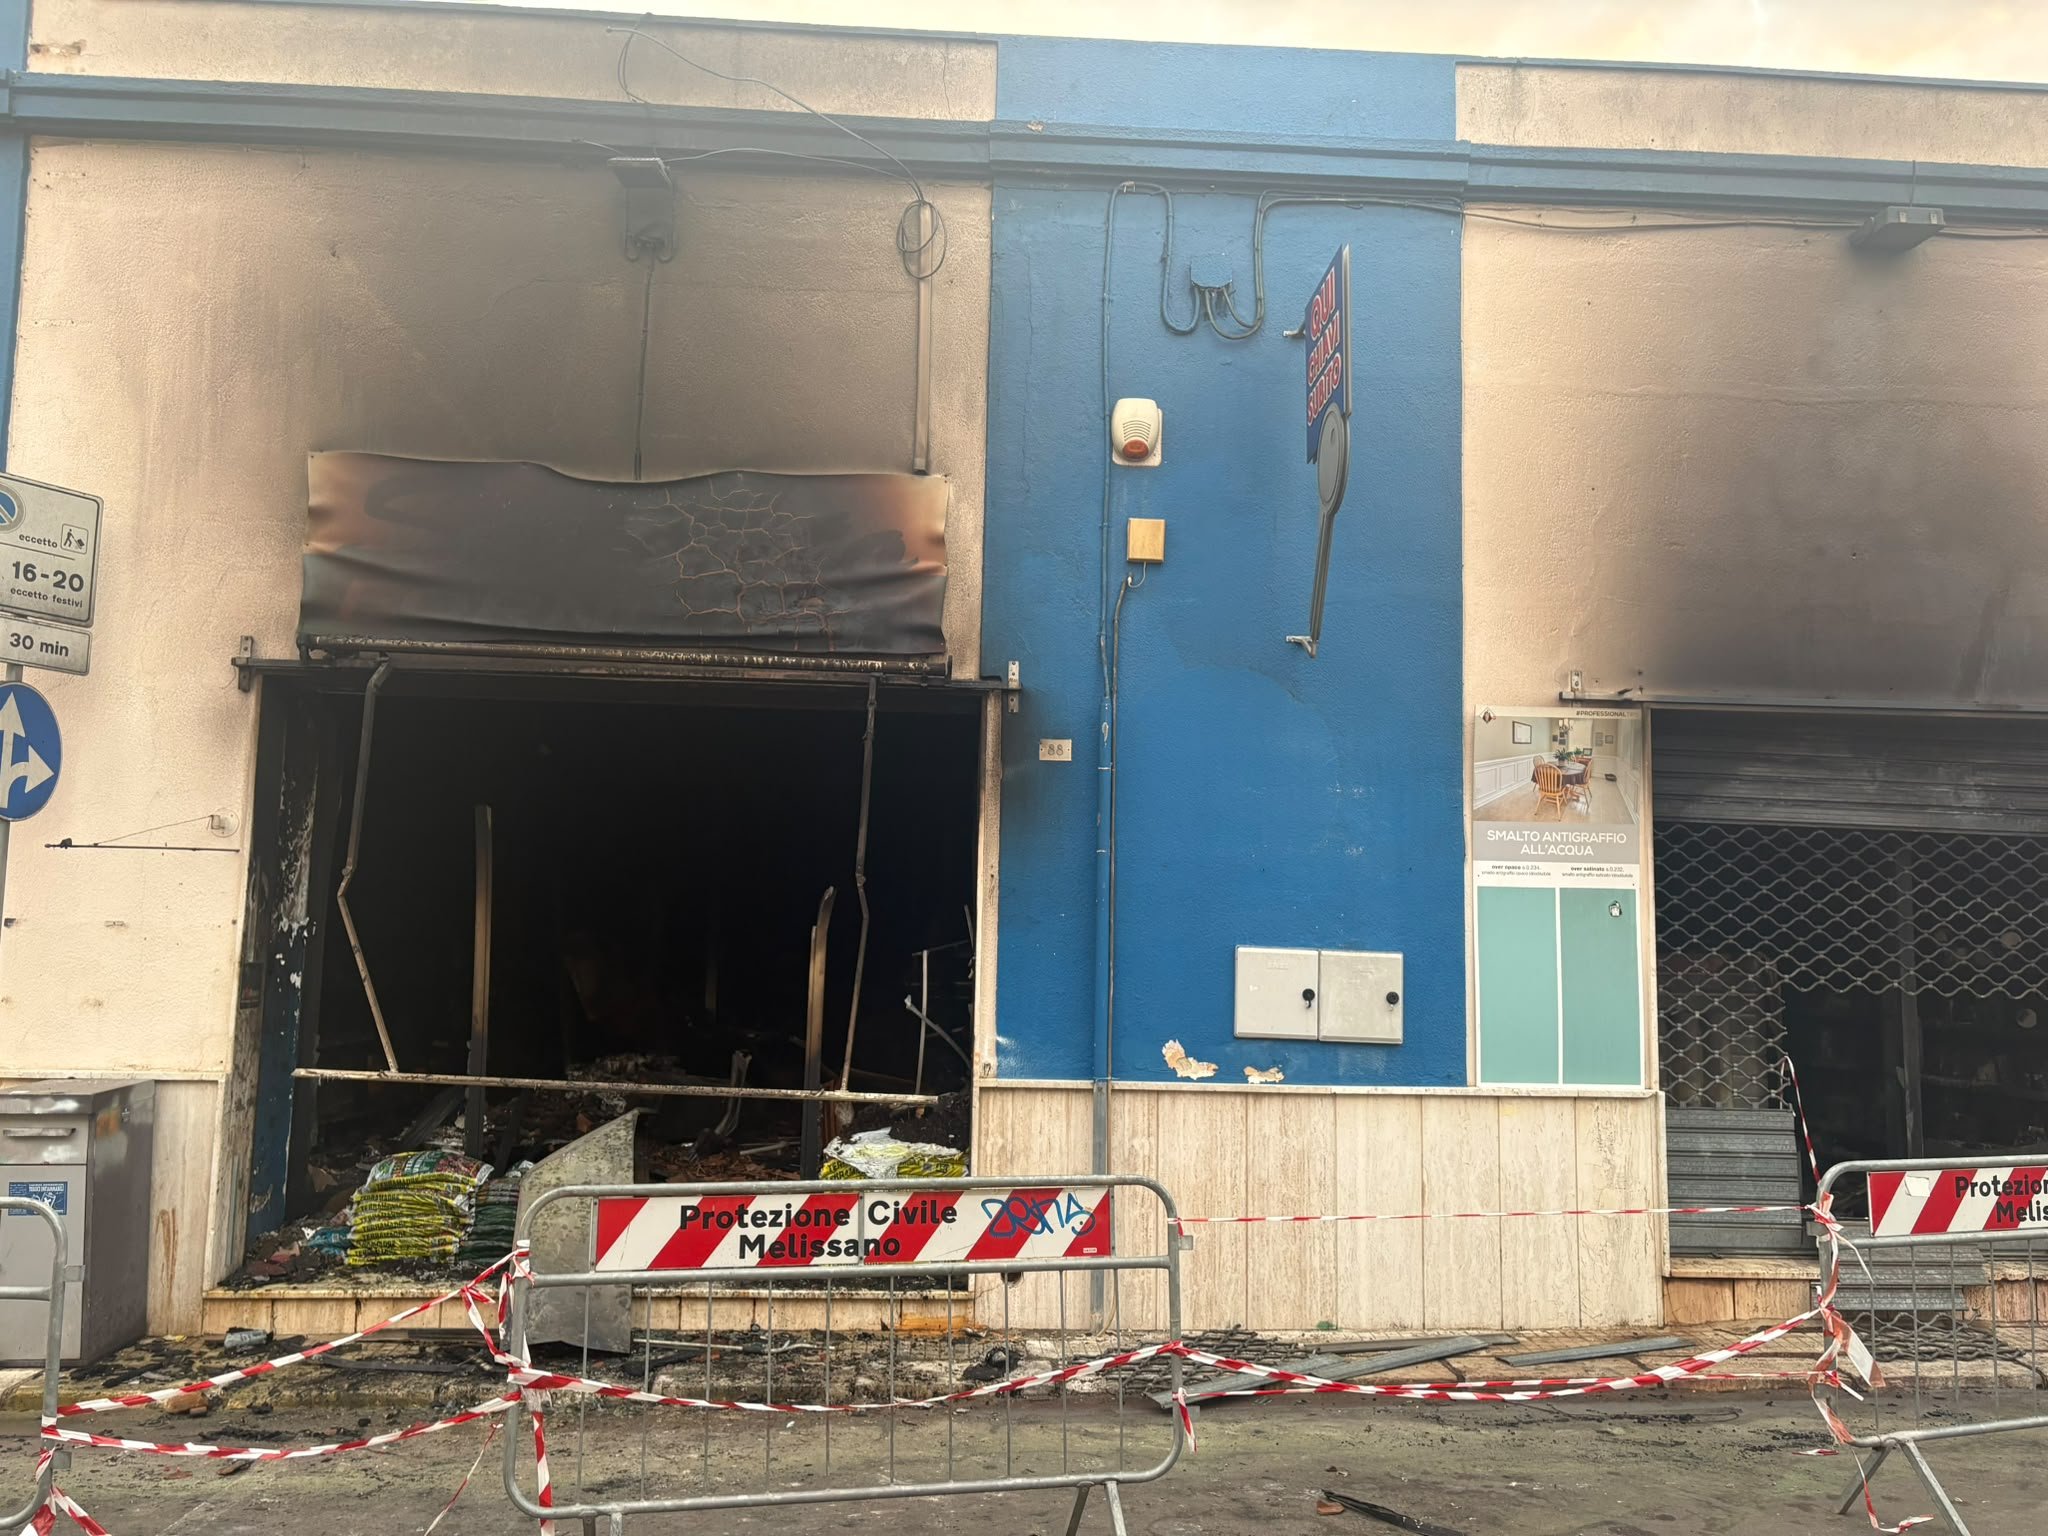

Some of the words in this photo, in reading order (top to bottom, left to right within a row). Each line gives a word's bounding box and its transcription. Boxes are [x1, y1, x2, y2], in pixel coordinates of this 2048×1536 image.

[1311, 267, 1335, 341] QUI
[1308, 311, 1340, 387] CHIAVI
[1307, 352, 1342, 427] SUBITO
[18, 533, 58, 548] eccetto
[12, 561, 84, 592] 16-20
[10, 587, 49, 601] eccetto
[52, 594, 83, 608] festivi
[9, 632, 35, 650] 30
[39, 641, 70, 657] min
[1047, 743, 1064, 756] 88
[1487, 830, 1540, 842] SMALTO
[1542, 831, 1627, 844] ANTIGRAFFIO
[1520, 844, 1594, 856] ALL'ACQUA
[680, 1203, 850, 1229] Protezione
[867, 1200, 957, 1225] Civile
[738, 1233, 900, 1259] Melissano
